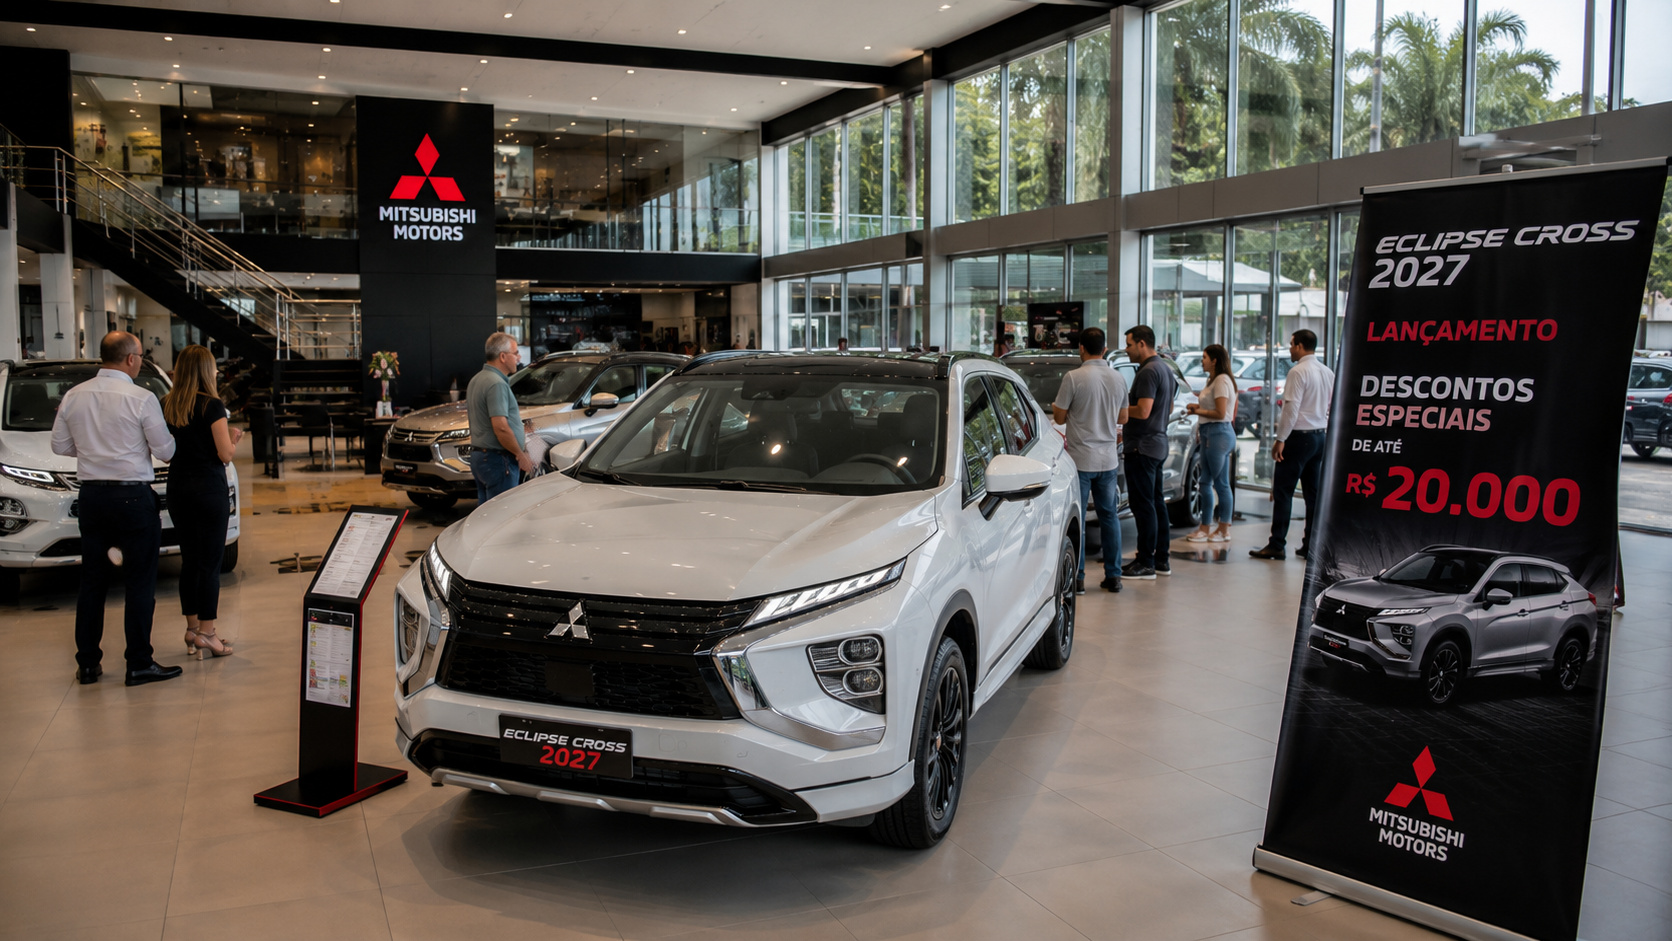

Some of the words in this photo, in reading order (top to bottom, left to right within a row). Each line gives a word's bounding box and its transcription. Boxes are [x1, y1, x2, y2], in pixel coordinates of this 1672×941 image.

[379, 206, 476, 224] MITSUBISHI
[393, 224, 464, 242] MOTORS
[1375, 228, 1510, 254] ECLIPSE
[1513, 219, 1640, 246] CROSS
[1368, 254, 1471, 289] 2027
[1366, 318, 1558, 346] LANÇAMENTO
[1360, 375, 1535, 403] DESCONTOS
[1356, 404, 1492, 432] ESPECIAIS
[1351, 438, 1372, 452] DE
[1373, 436, 1403, 454] ATÉ
[1345, 472, 1377, 498] R$
[1381, 466, 1581, 527] 20.000
[503, 728, 569, 746] ECLIPSE
[572, 737, 628, 753] CROSS
[539, 745, 602, 771] 2027
[1369, 806, 1465, 850] MITSUBISHI
[1378, 827, 1448, 862] MOTORS
